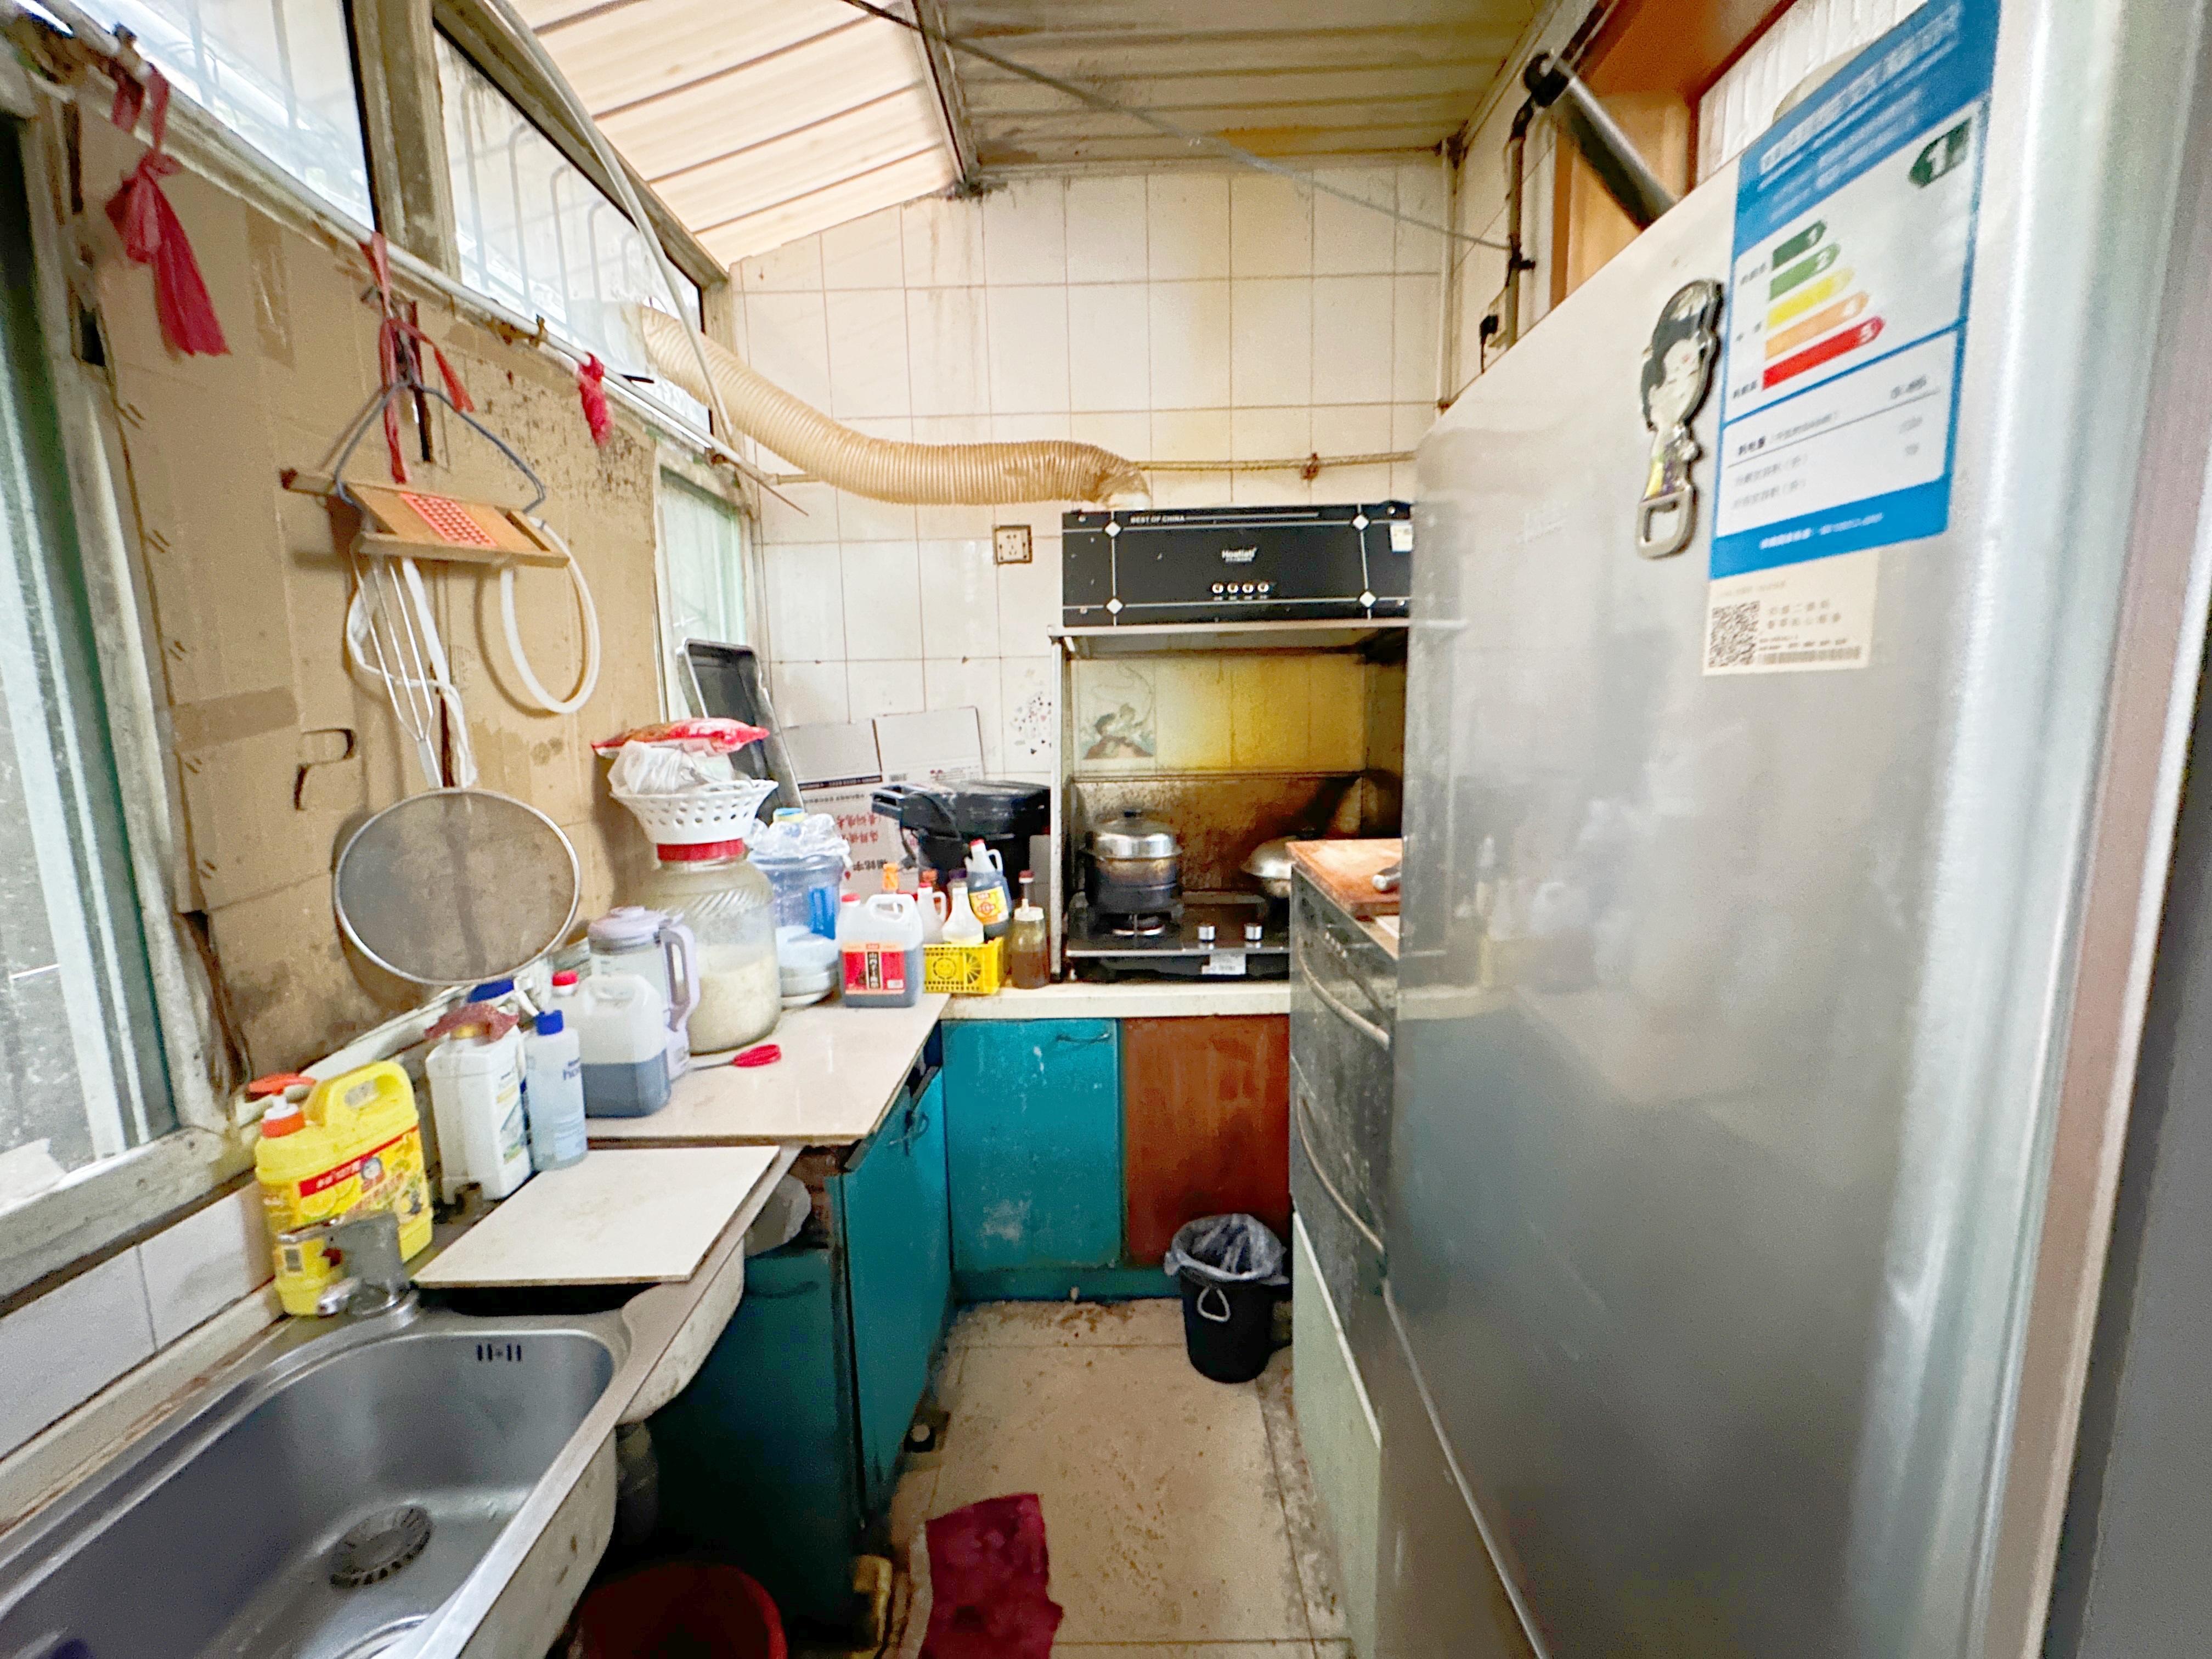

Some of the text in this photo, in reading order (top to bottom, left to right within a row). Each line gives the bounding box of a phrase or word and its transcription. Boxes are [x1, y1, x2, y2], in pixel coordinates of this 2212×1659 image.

[1926, 136, 1949, 177] 1
[1816, 251, 1830, 270] 2
[1162, 515, 1185, 523] CHINA
